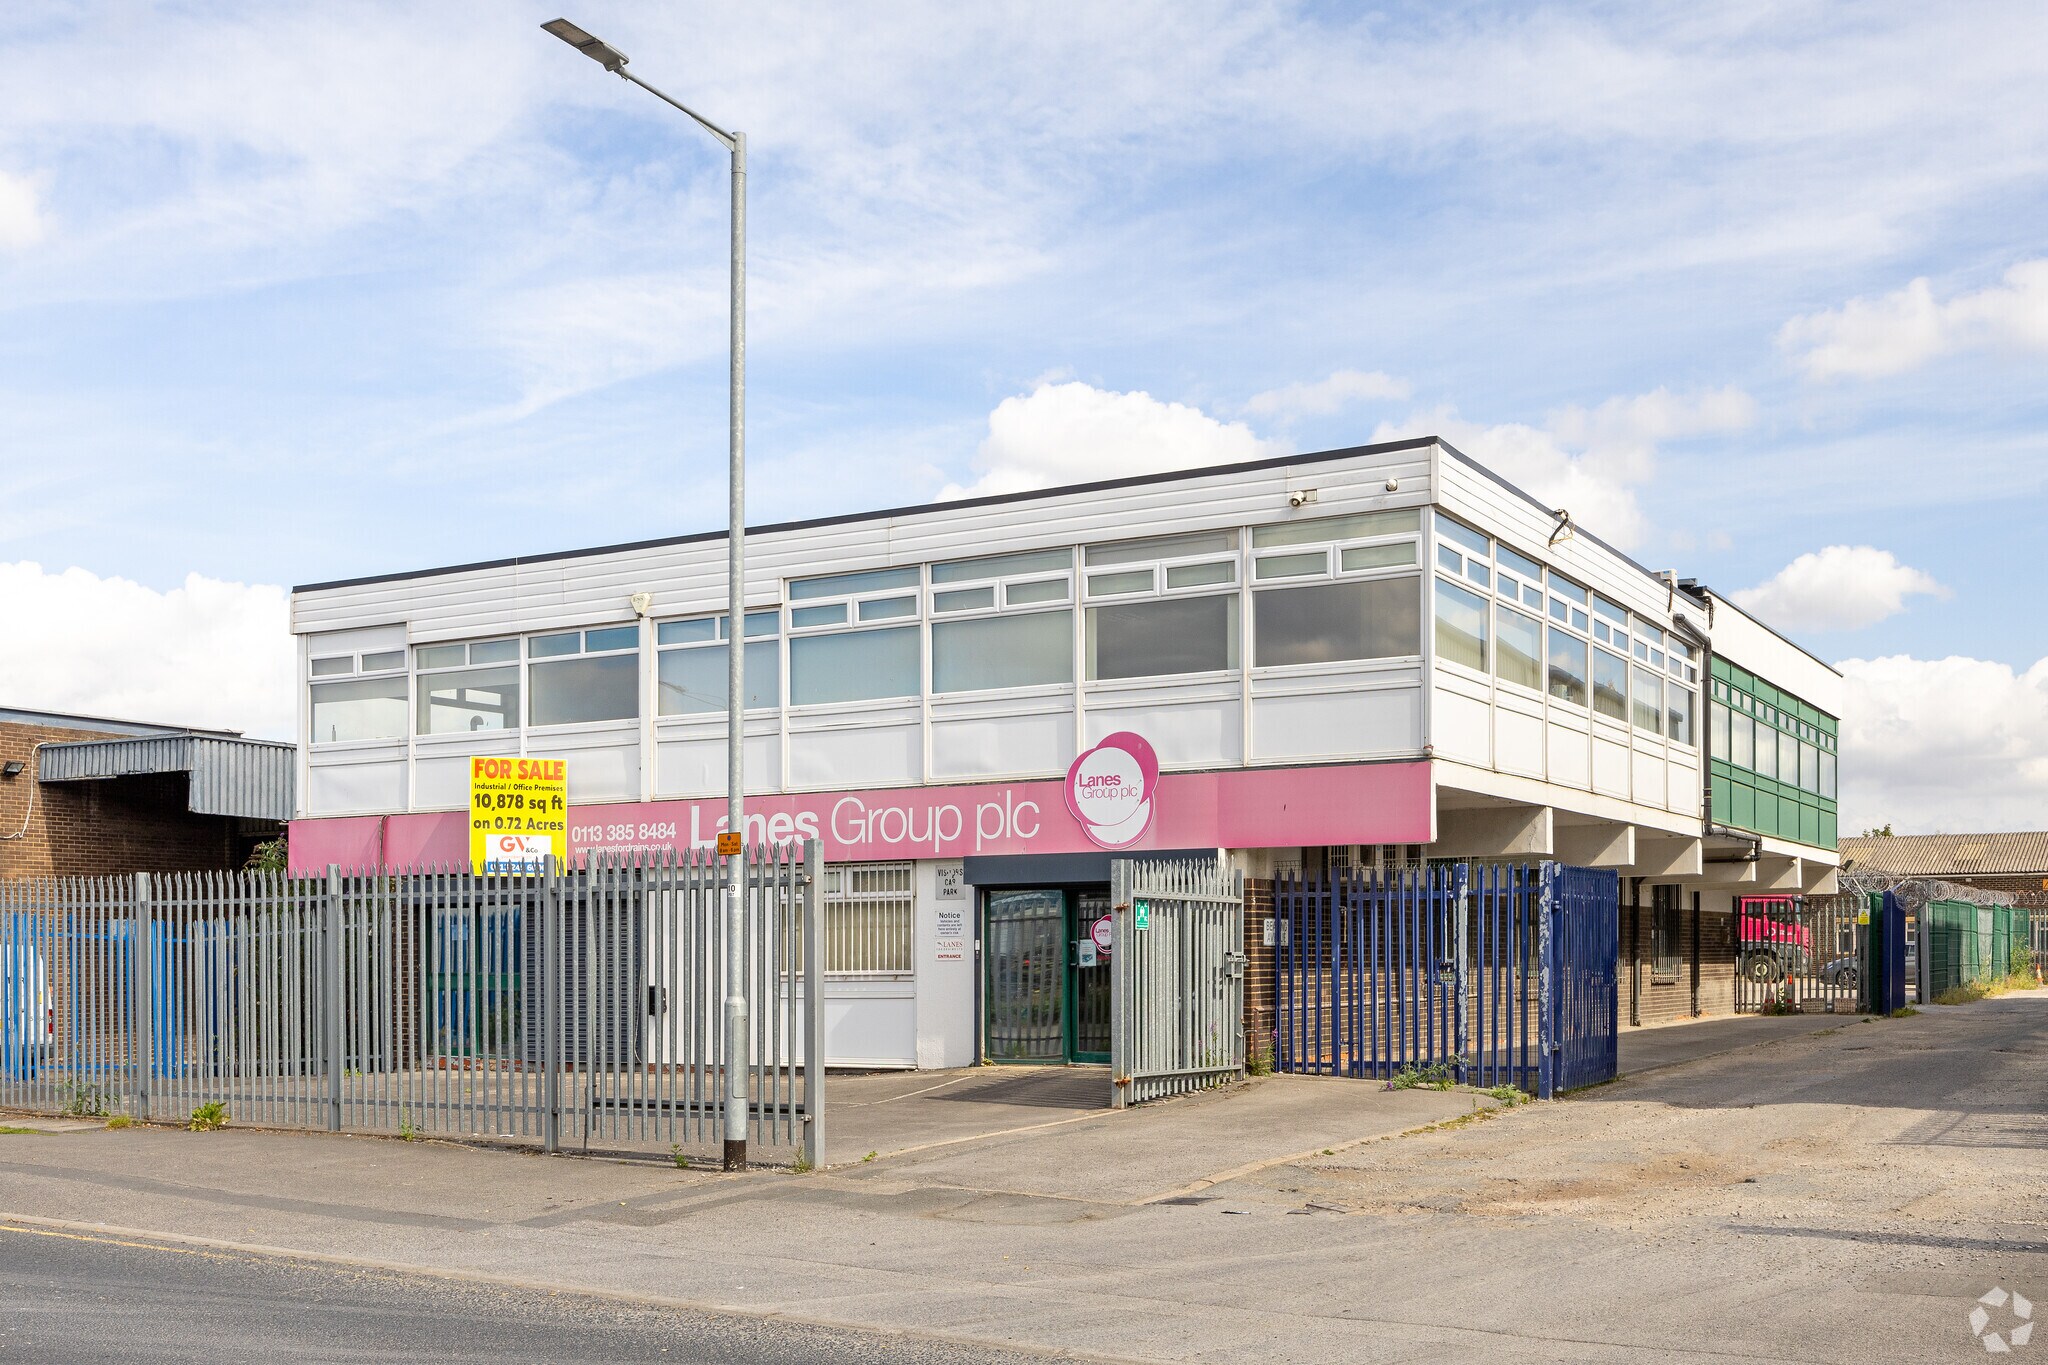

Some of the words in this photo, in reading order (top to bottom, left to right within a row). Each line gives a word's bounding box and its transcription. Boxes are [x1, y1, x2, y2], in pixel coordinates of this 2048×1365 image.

[474, 758, 512, 779] FOR
[518, 759, 564, 781] SALE
[534, 784, 563, 792] Premises
[1079, 774, 1121, 788] Lanes
[1082, 785, 1118, 800] Group
[1121, 784, 1138, 800] plc
[474, 793, 524, 811] 10,878
[529, 798, 547, 814] sq
[551, 795, 563, 810] ft
[473, 819, 490, 829] on
[495, 816, 522, 830] 0.72
[526, 817, 564, 830] Acres
[831, 796, 962, 853] Group
[976, 789, 1040, 852] plc
[571, 825, 603, 842] 0113
[606, 823, 635, 841] 385
[638, 822, 677, 840] 8484
[575, 842, 672, 854] wwwlanesfordrains.co.uk
[728, 884, 736, 892] 10
